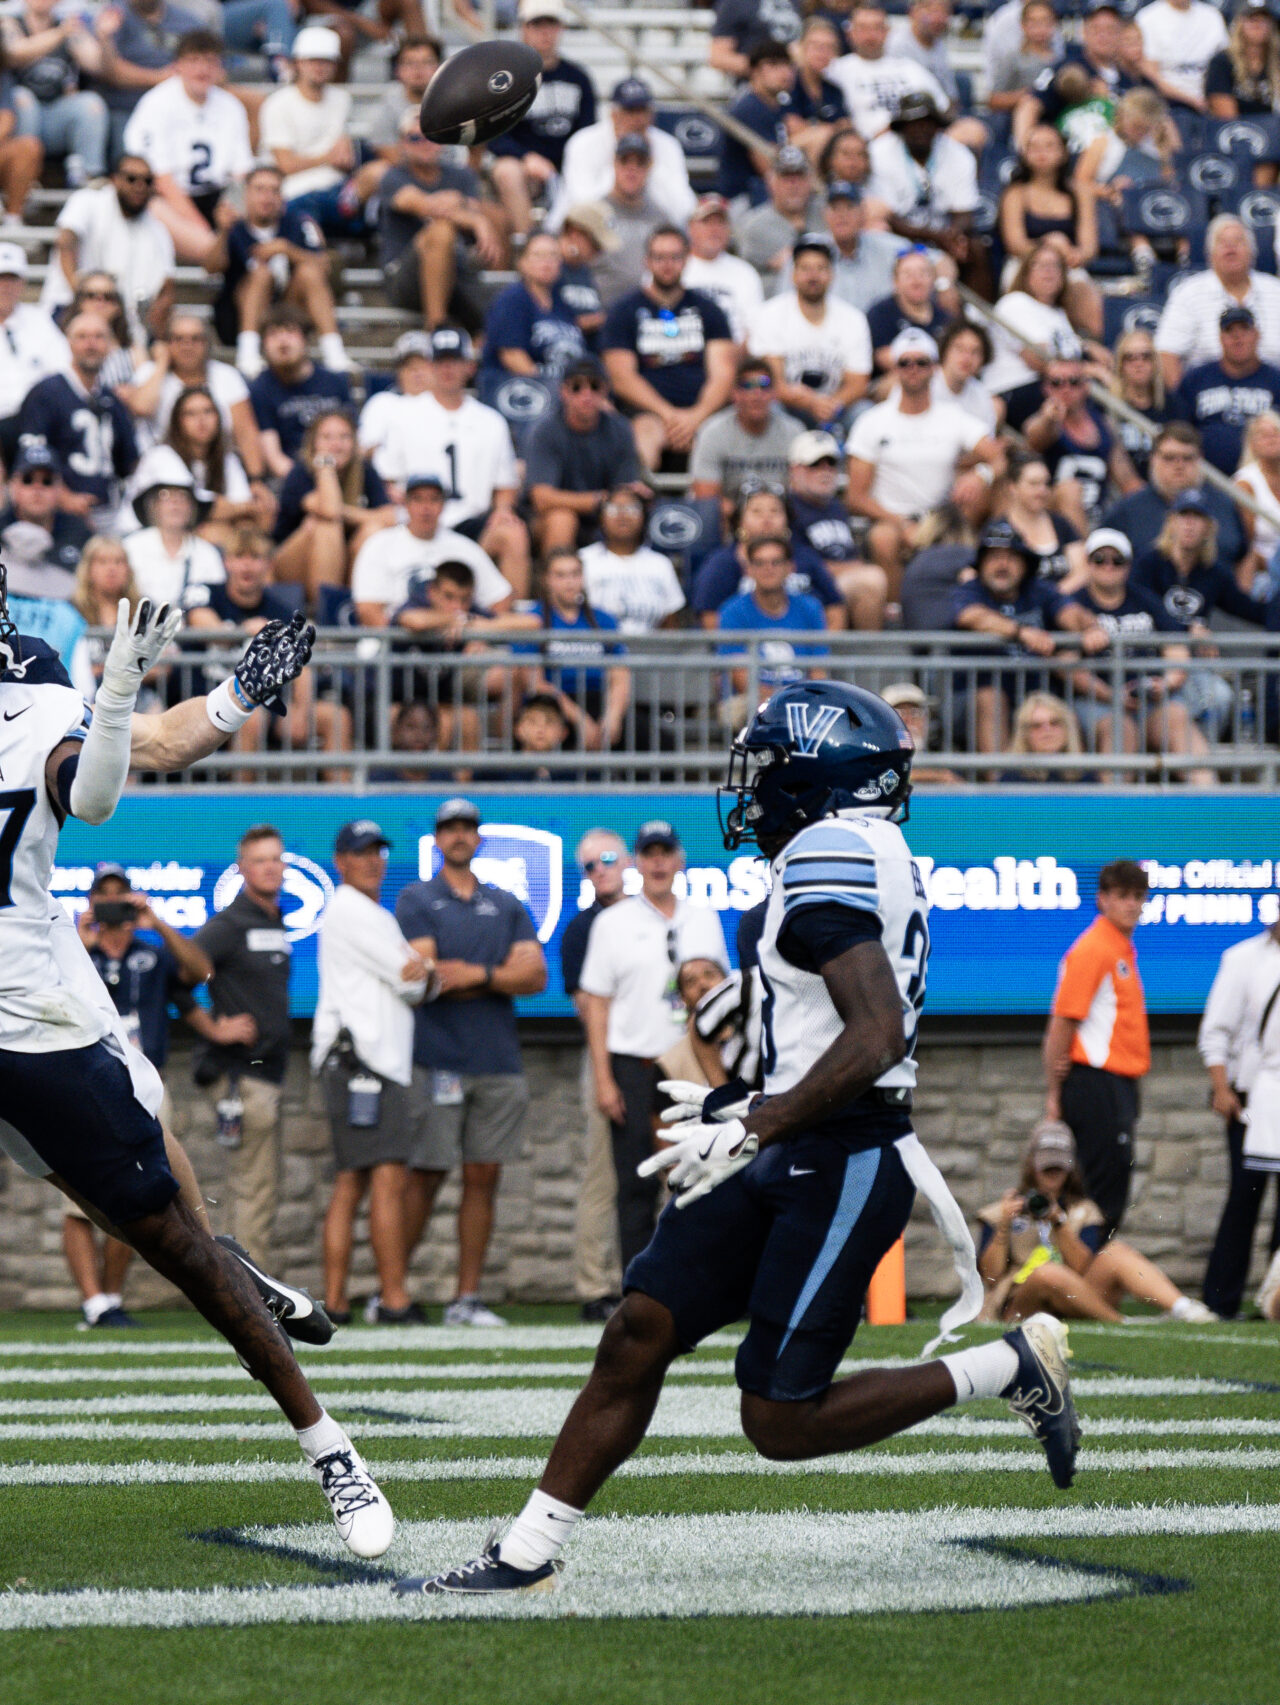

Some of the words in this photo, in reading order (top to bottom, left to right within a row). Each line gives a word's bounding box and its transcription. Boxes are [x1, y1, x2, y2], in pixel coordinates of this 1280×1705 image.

[190, 143, 213, 186] 2
[445, 443, 463, 499] 1
[785, 702, 846, 758] V
